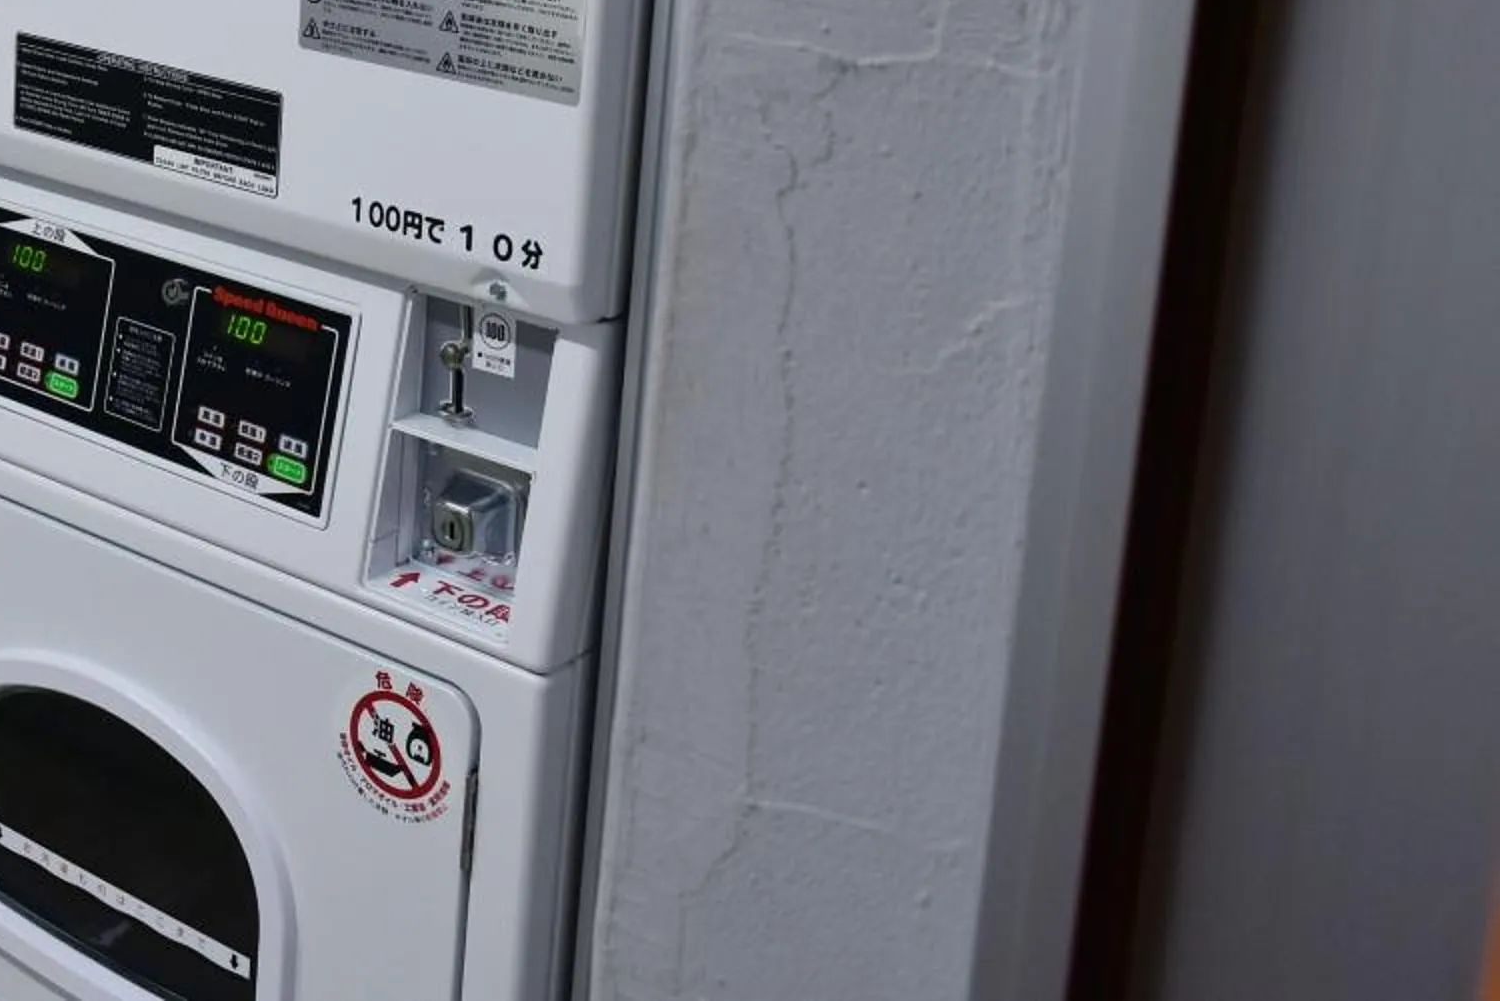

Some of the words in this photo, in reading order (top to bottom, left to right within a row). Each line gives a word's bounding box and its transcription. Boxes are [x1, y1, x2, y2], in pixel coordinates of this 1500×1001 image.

[12, 245, 47, 272] 100
[227, 314, 268, 344] 100
[372, 718, 395, 744] 油
